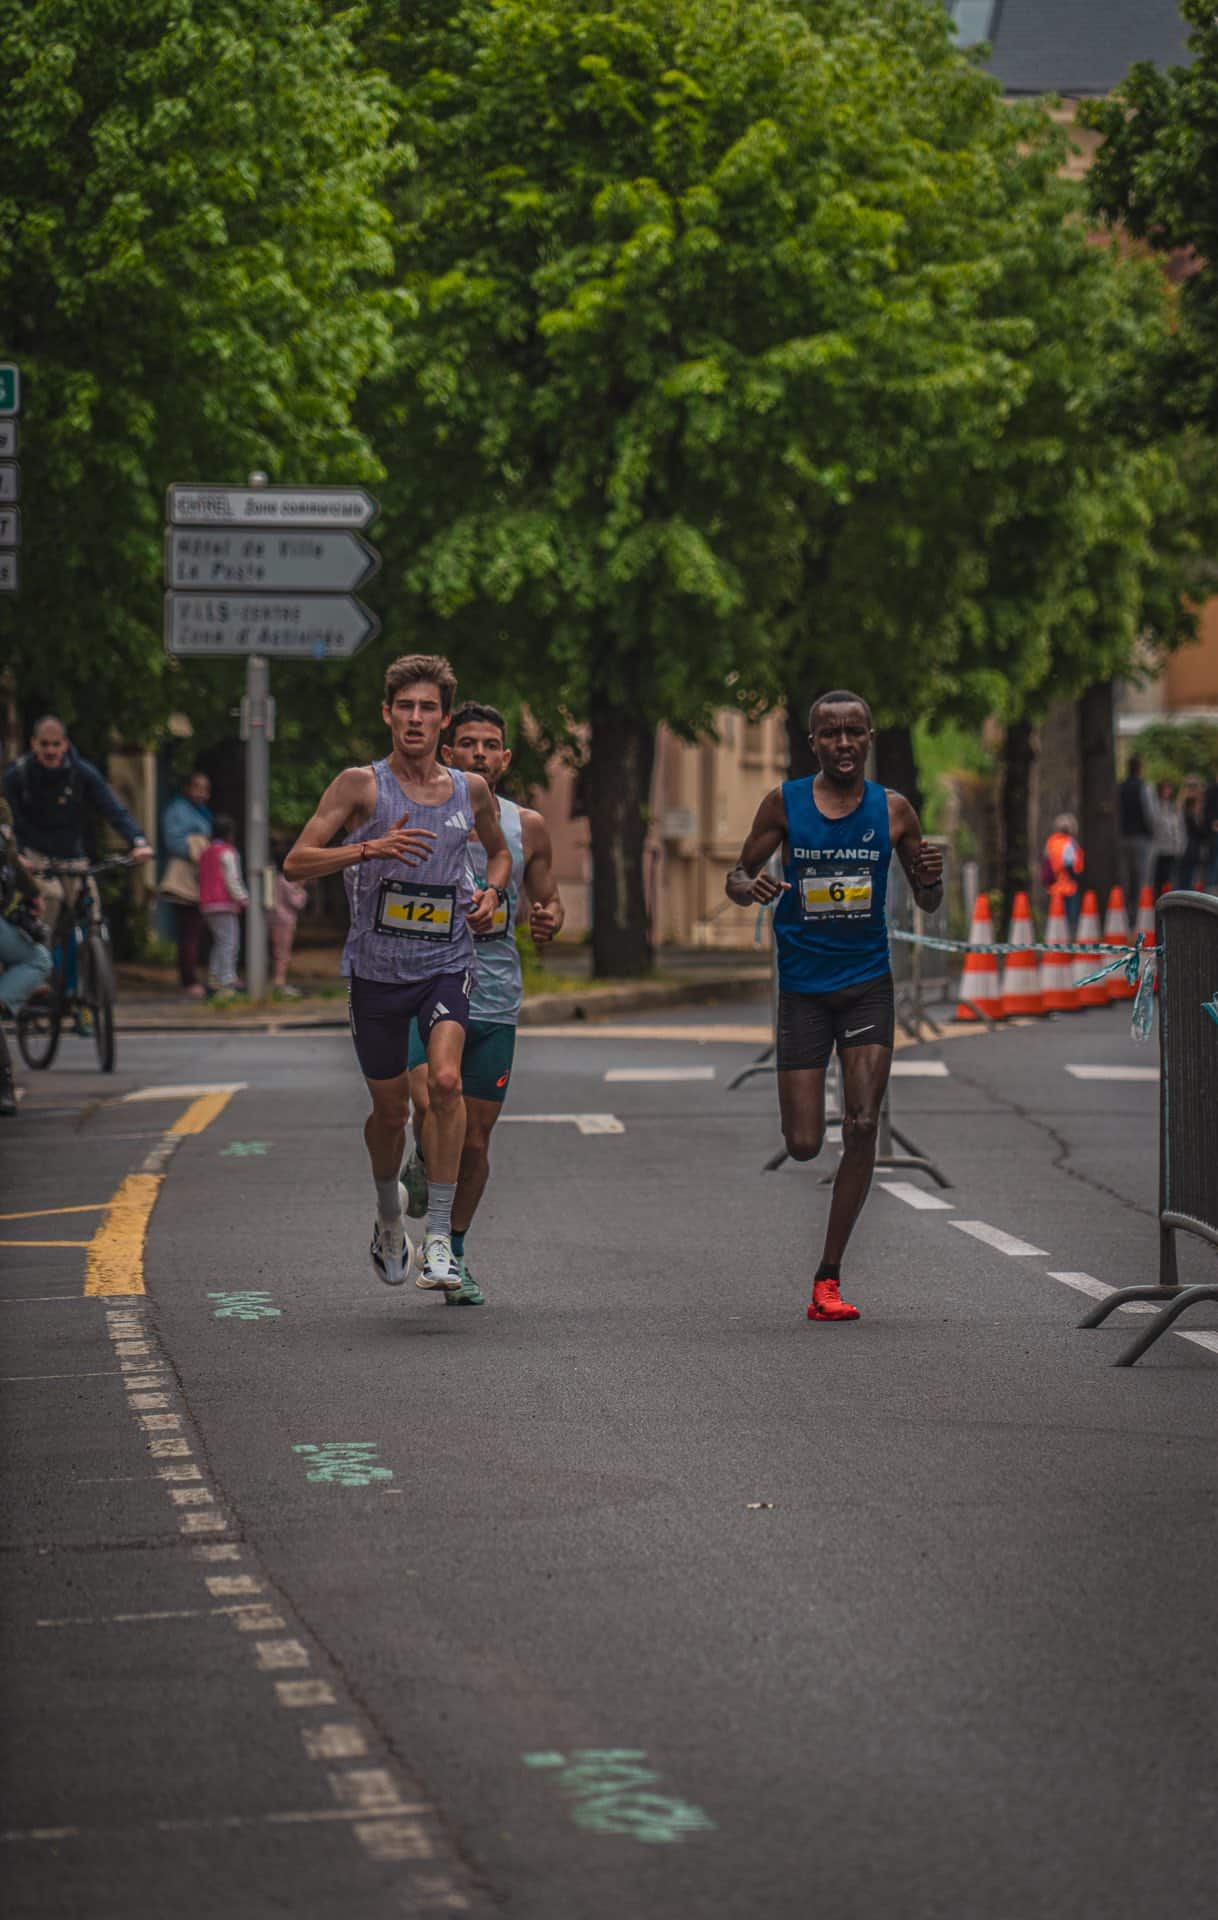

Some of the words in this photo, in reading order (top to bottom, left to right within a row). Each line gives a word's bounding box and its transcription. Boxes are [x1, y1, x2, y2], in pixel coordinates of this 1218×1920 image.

[243, 540, 265, 558] de
[793, 847, 880, 861] DISTANCE
[829, 882, 846, 902] 6
[402, 900, 436, 922] 12
